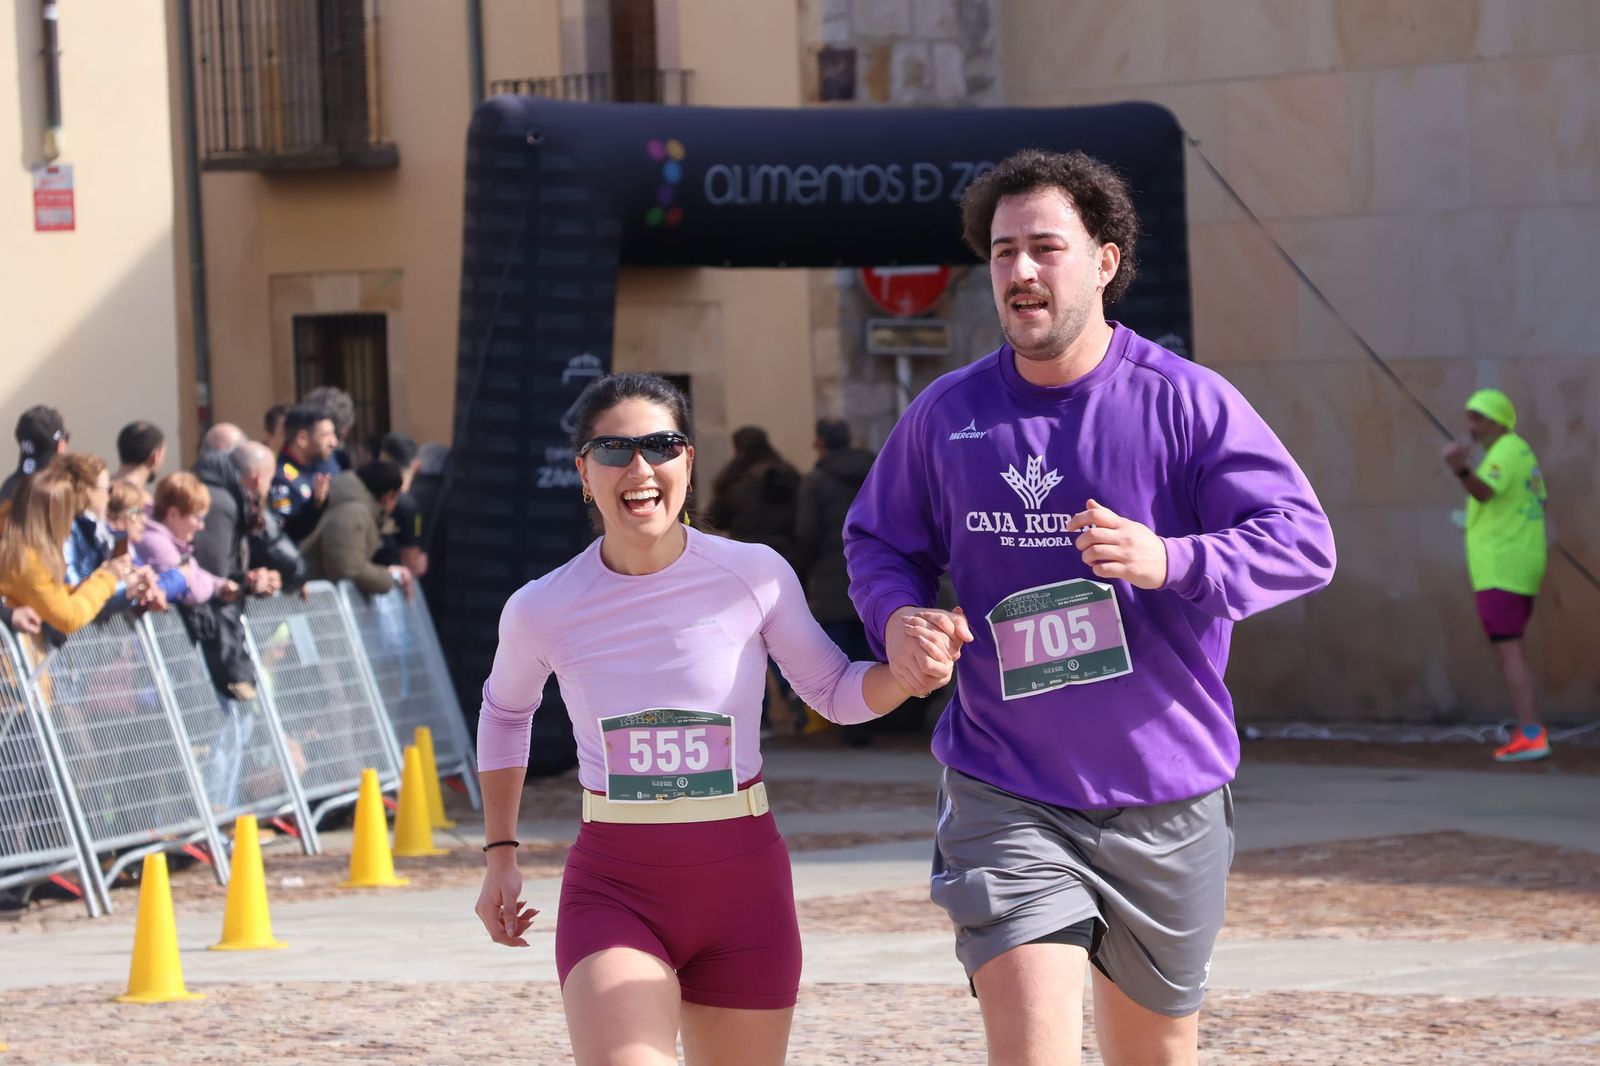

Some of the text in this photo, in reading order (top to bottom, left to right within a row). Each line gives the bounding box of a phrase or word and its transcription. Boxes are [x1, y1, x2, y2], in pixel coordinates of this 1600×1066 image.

[949, 431, 987, 441] MERCURY
[537, 466, 582, 487] ZAM
[966, 511, 1097, 534] CAJA RUR
[1000, 536, 1073, 547] DE ZAMORA
[1014, 607, 1096, 663] 705
[629, 728, 710, 773] 555
